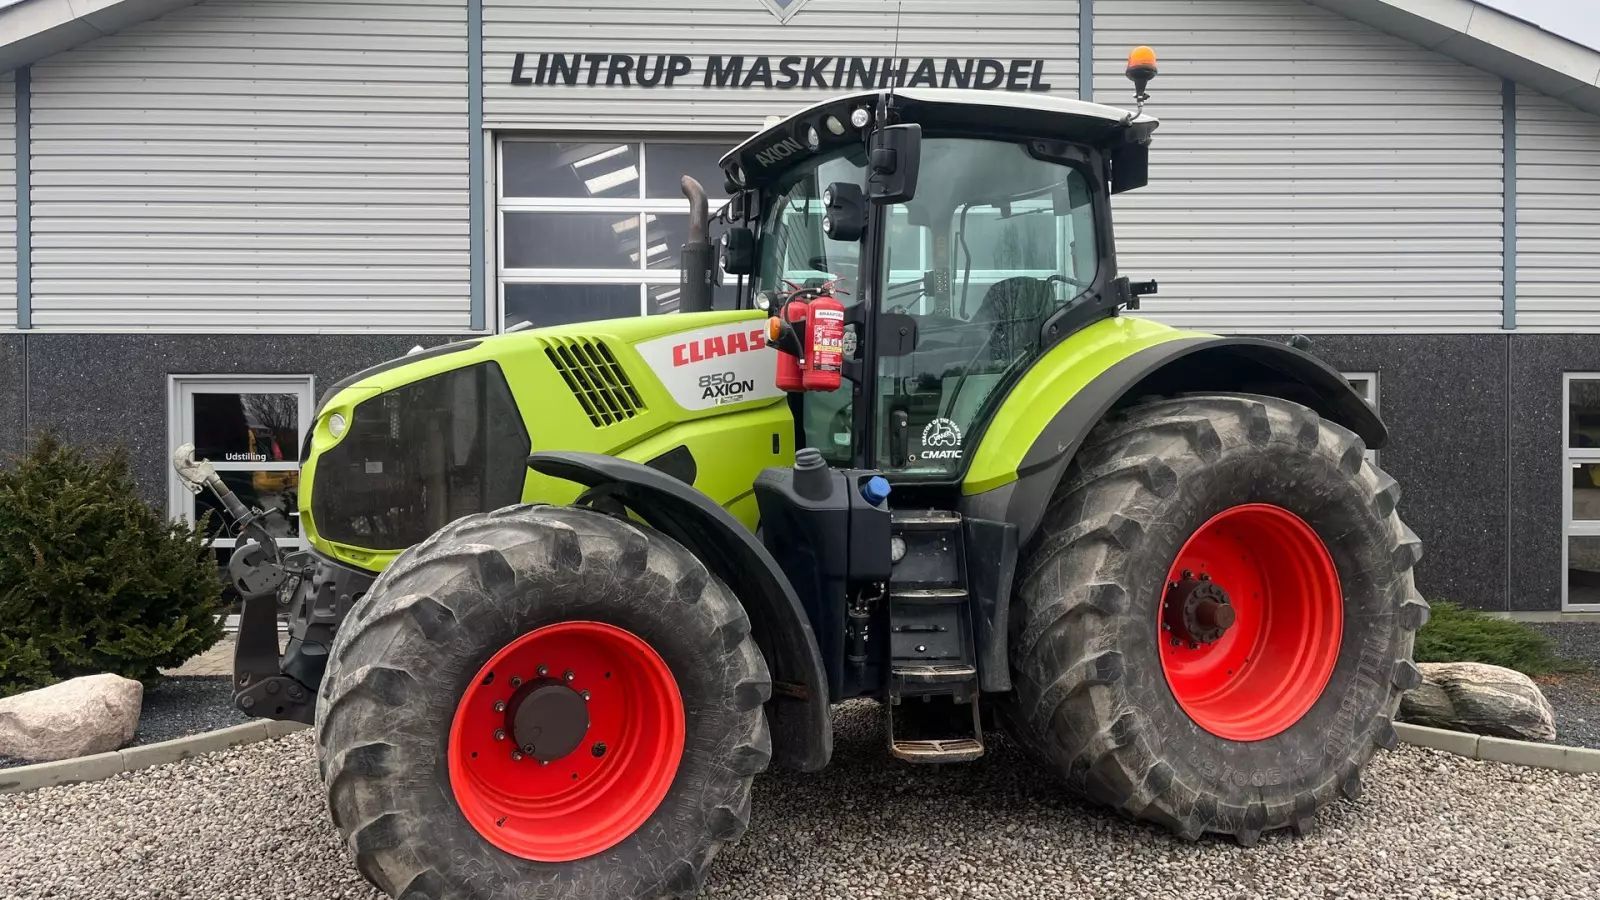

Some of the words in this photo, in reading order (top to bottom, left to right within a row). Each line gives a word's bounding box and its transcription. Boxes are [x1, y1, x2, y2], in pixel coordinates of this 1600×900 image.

[510, 52, 692, 88] LINTRUP
[703, 55, 1051, 92] MASKINHANDEL
[755, 136, 804, 168] AXION
[672, 329, 766, 368] CLAAS
[698, 371, 736, 388] 850
[701, 379, 754, 400] AXION
[225, 452, 267, 462] Udstilling
[921, 450, 963, 459] CMATIC
